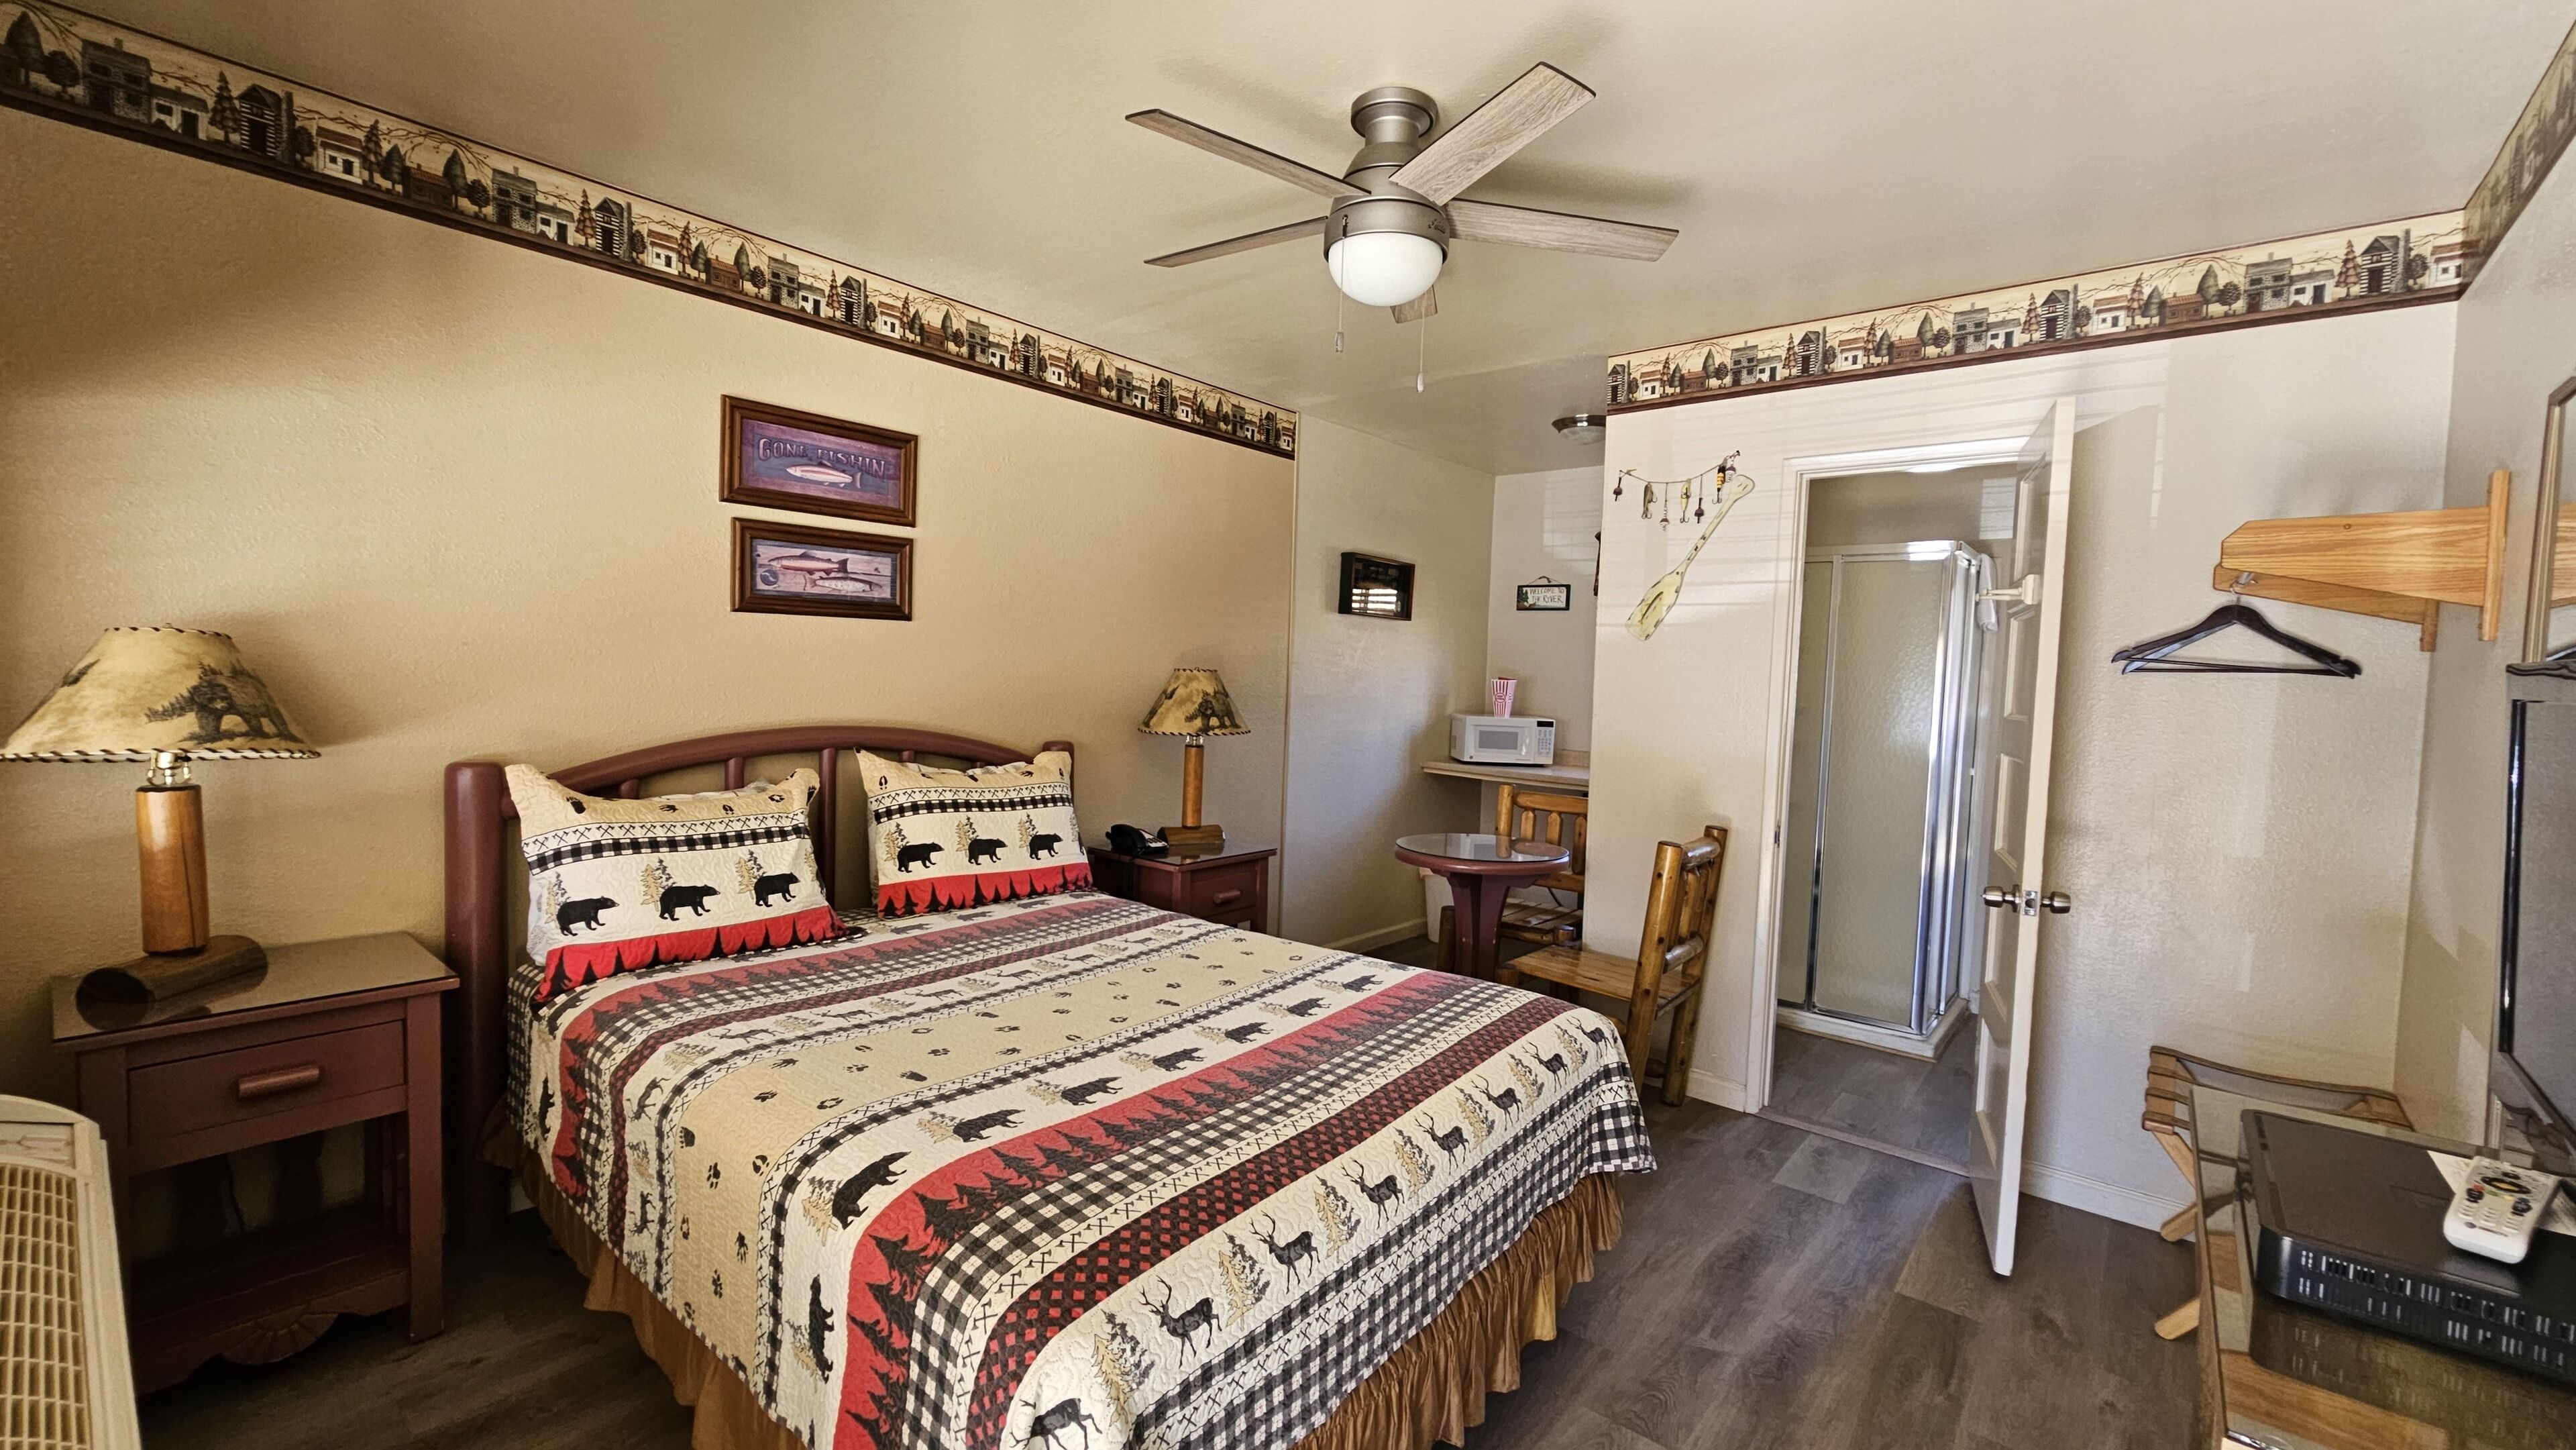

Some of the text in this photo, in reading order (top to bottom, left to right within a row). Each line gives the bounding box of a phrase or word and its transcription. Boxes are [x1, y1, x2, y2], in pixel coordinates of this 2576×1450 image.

[759, 437, 885, 479] GONE FISHIN
[1543, 594, 1564, 603] RIVER
